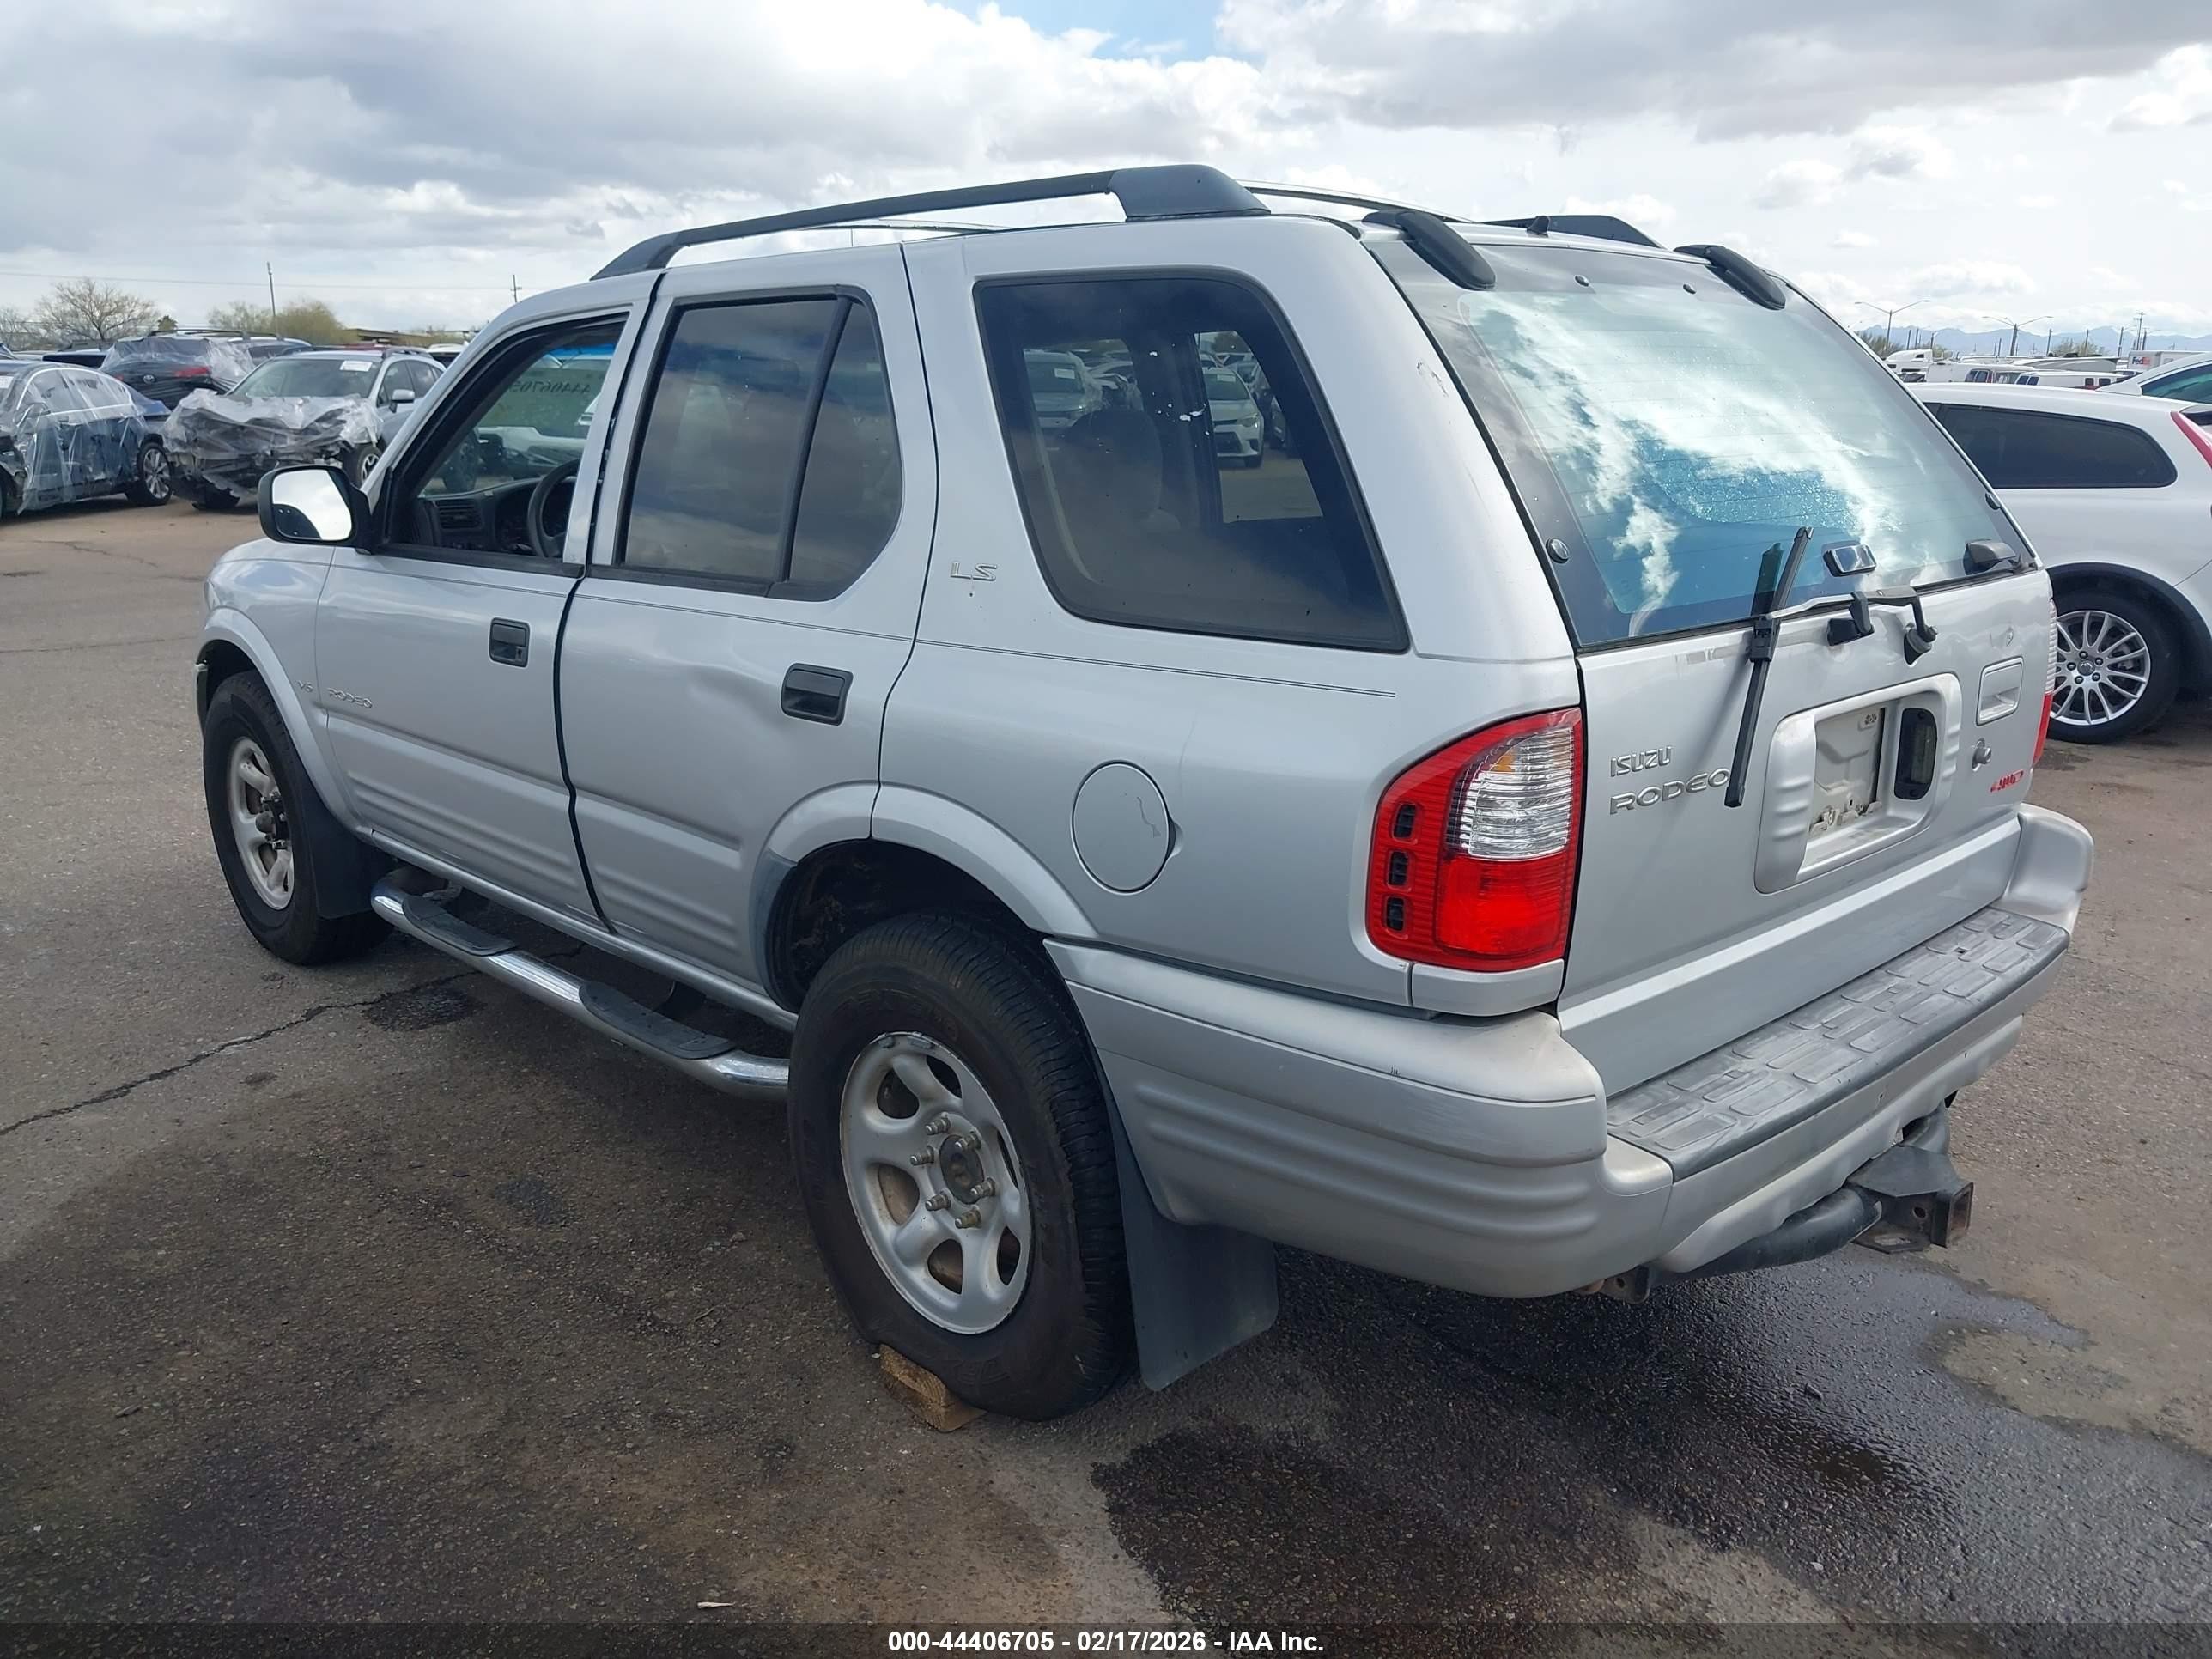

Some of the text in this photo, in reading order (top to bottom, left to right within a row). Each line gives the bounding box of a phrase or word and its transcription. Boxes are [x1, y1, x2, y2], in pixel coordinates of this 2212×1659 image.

[950, 562, 998, 581] LS
[327, 687, 373, 708] RODEO
[1610, 745, 1673, 777] ISUZU
[1609, 768, 1730, 815] RODEO
